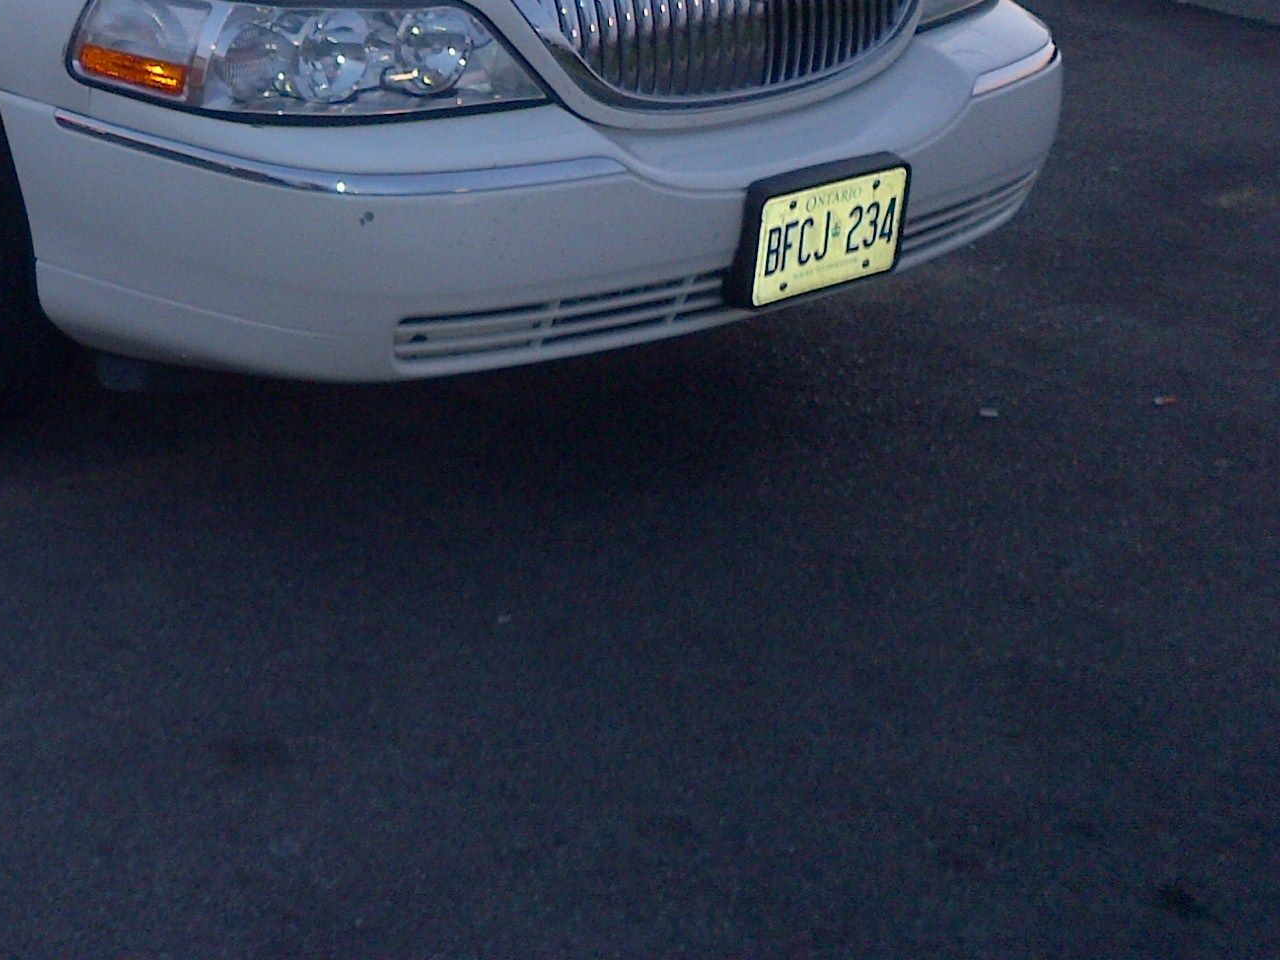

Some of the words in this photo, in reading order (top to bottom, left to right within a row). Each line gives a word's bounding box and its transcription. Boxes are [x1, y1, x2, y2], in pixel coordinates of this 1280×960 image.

[806, 186, 862, 212] ONTARIO
[764, 210, 831, 277] BFCJ
[845, 197, 897, 255] 234
